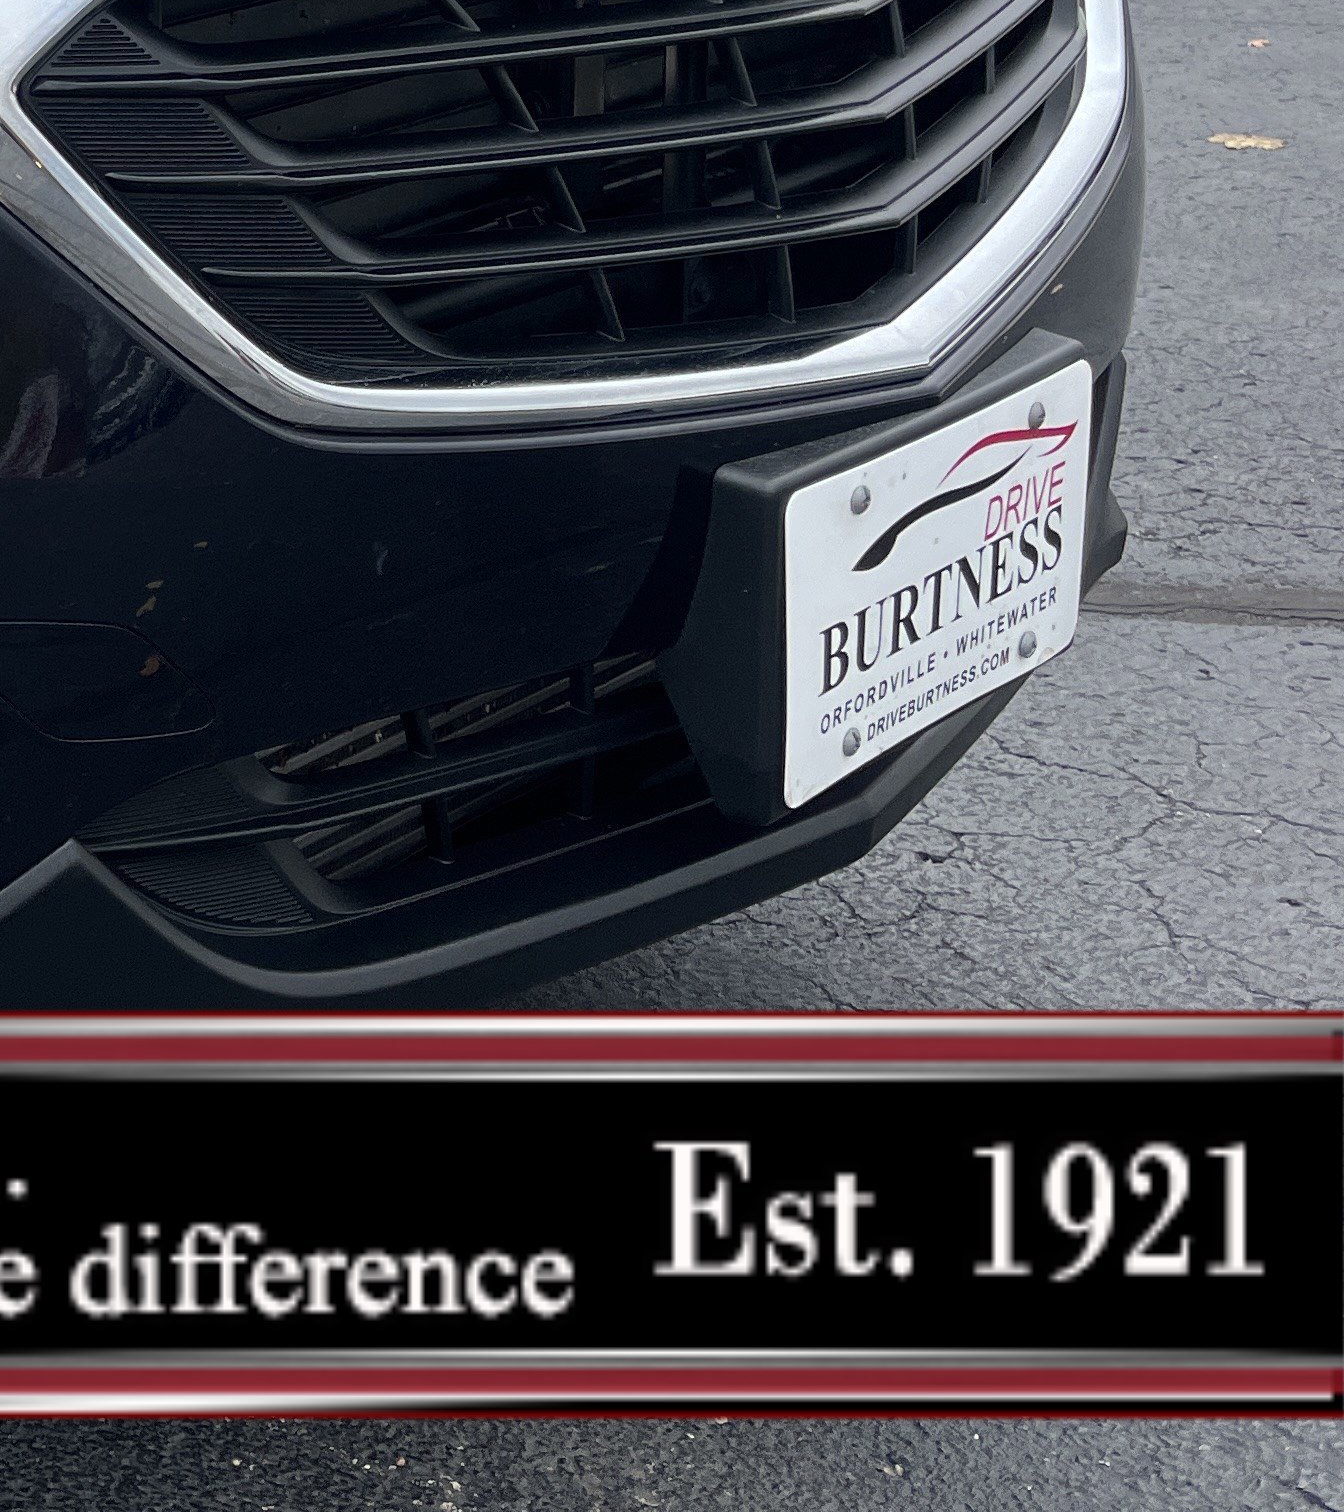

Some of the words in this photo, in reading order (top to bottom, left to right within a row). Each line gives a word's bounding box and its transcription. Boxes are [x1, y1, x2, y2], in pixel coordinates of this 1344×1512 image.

[984, 460, 1067, 543] DRIVE
[817, 504, 1063, 698] BURTNESS
[820, 651, 936, 736] ORFORDVILLE
[956, 586, 1057, 658] WHITEWATER
[867, 646, 1010, 742] DRIVEBURTNESS.COM
